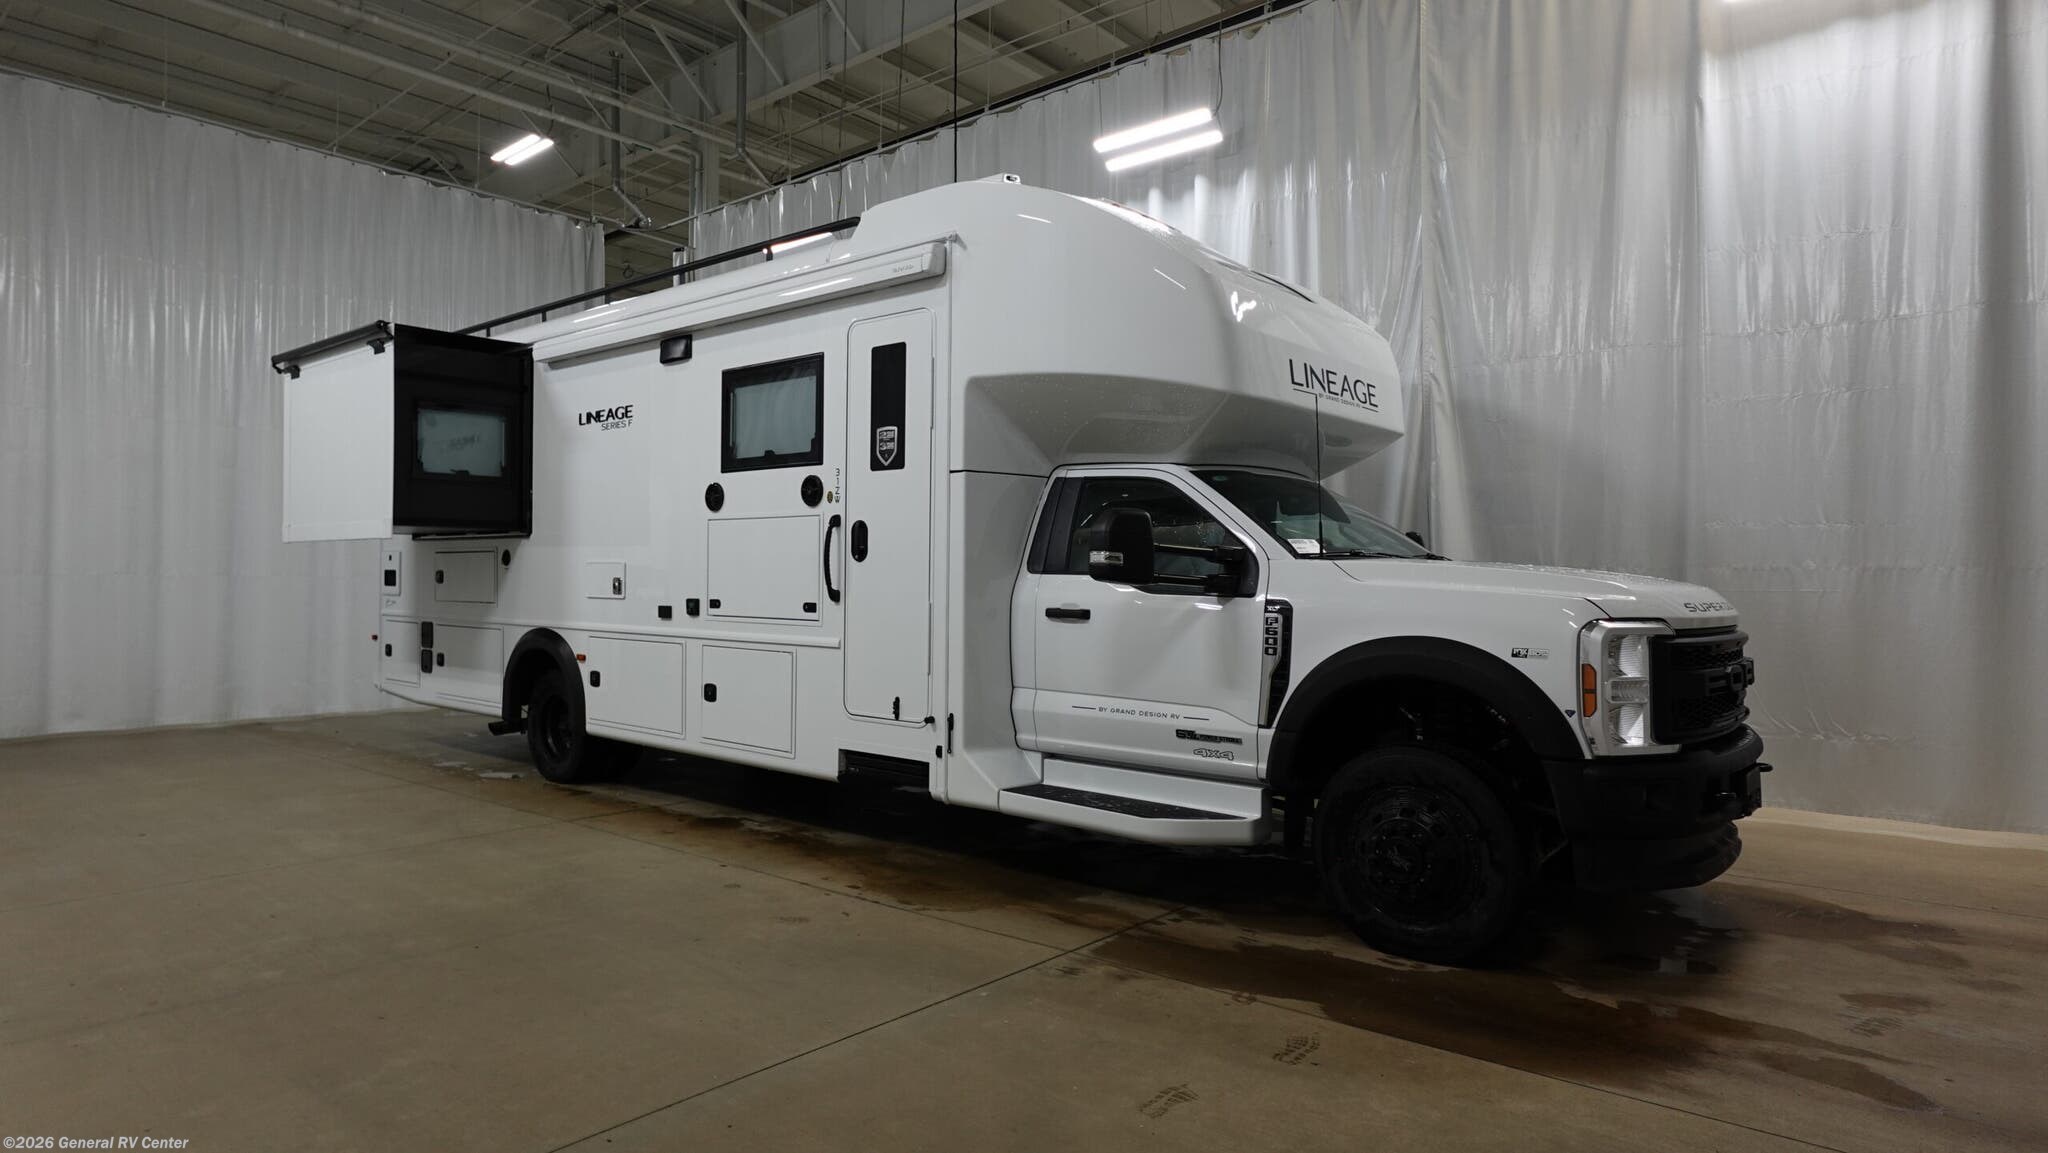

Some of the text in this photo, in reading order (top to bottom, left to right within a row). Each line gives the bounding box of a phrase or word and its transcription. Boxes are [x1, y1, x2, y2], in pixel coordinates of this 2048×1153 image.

[1288, 358, 1379, 408] LINEAGE
[578, 404, 633, 426] LINEAGE
[601, 418, 633, 431] SERIES F
[1110, 708, 1136, 716] GRAND
[1138, 710, 1168, 719] DESIGN
[1170, 712, 1181, 720] RV
